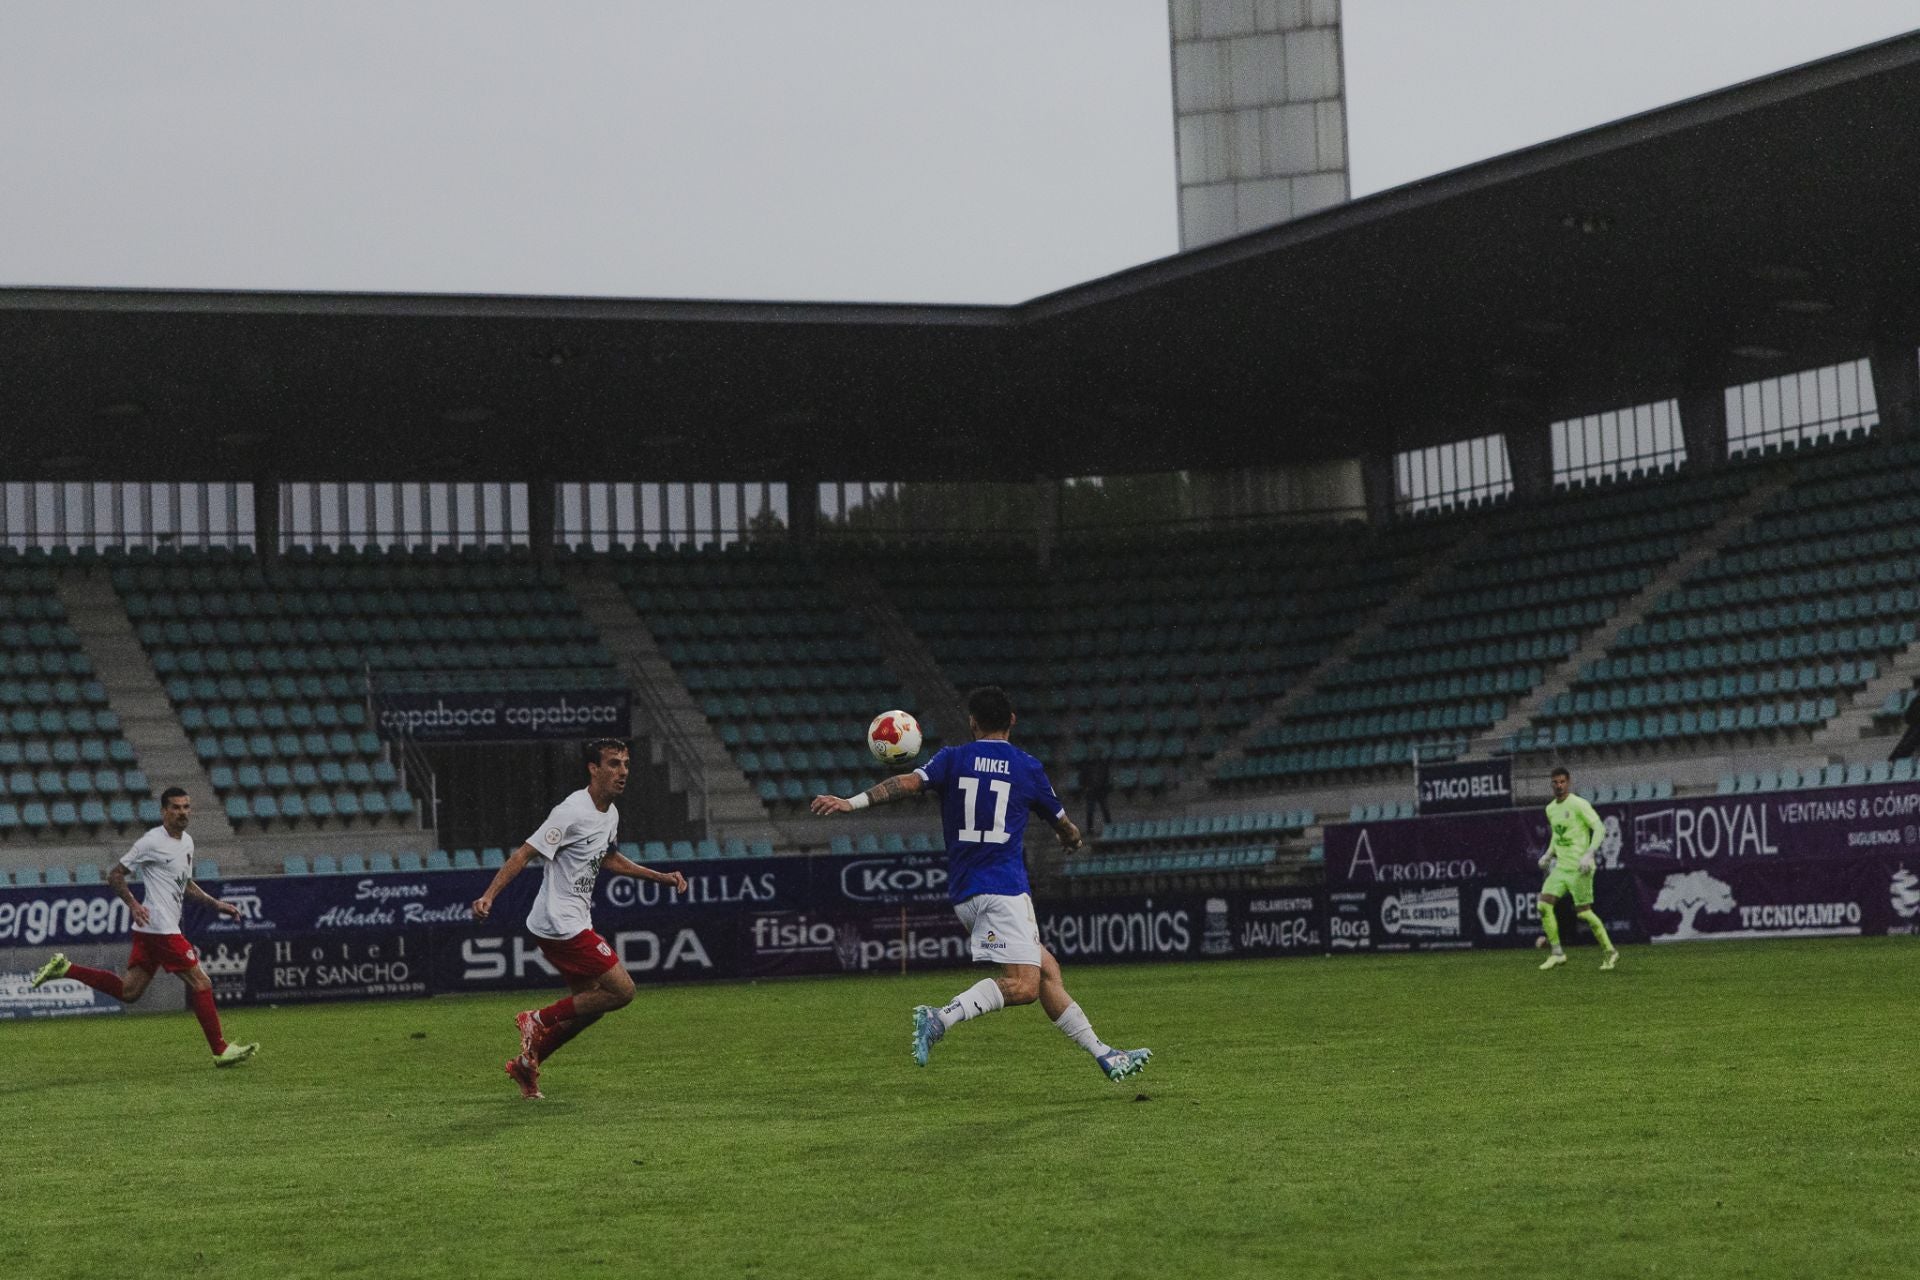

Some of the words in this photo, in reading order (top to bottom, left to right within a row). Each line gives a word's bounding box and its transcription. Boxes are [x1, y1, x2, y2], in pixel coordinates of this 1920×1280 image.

[381, 699, 496, 734] copaboca
[505, 697, 616, 731] copaboca
[974, 756, 1010, 775] MIKEL
[1432, 777, 1469, 801] TACO
[1471, 774, 1510, 798] BELL
[957, 776, 1011, 844] 11
[1778, 798, 1856, 823] VENTANAS
[1859, 797, 1870, 819] &
[1873, 789, 1920, 818] CÓMP
[1676, 802, 1778, 860] ROYAL
[355, 879, 428, 905] Seguros
[1515, 892, 1543, 921] PE
[402, 902, 473, 924] Revilla
[1059, 899, 1191, 955] euronics
[1330, 916, 1370, 938] Roca
[1739, 902, 1862, 928] TECNICAMPO
[751, 916, 835, 948] fisio
[1241, 917, 1307, 947] JAVIER
[275, 936, 406, 964] Hotel
[461, 928, 713, 980] SKDA
[273, 967, 309, 988] REY
[316, 962, 408, 986] SANCHO
